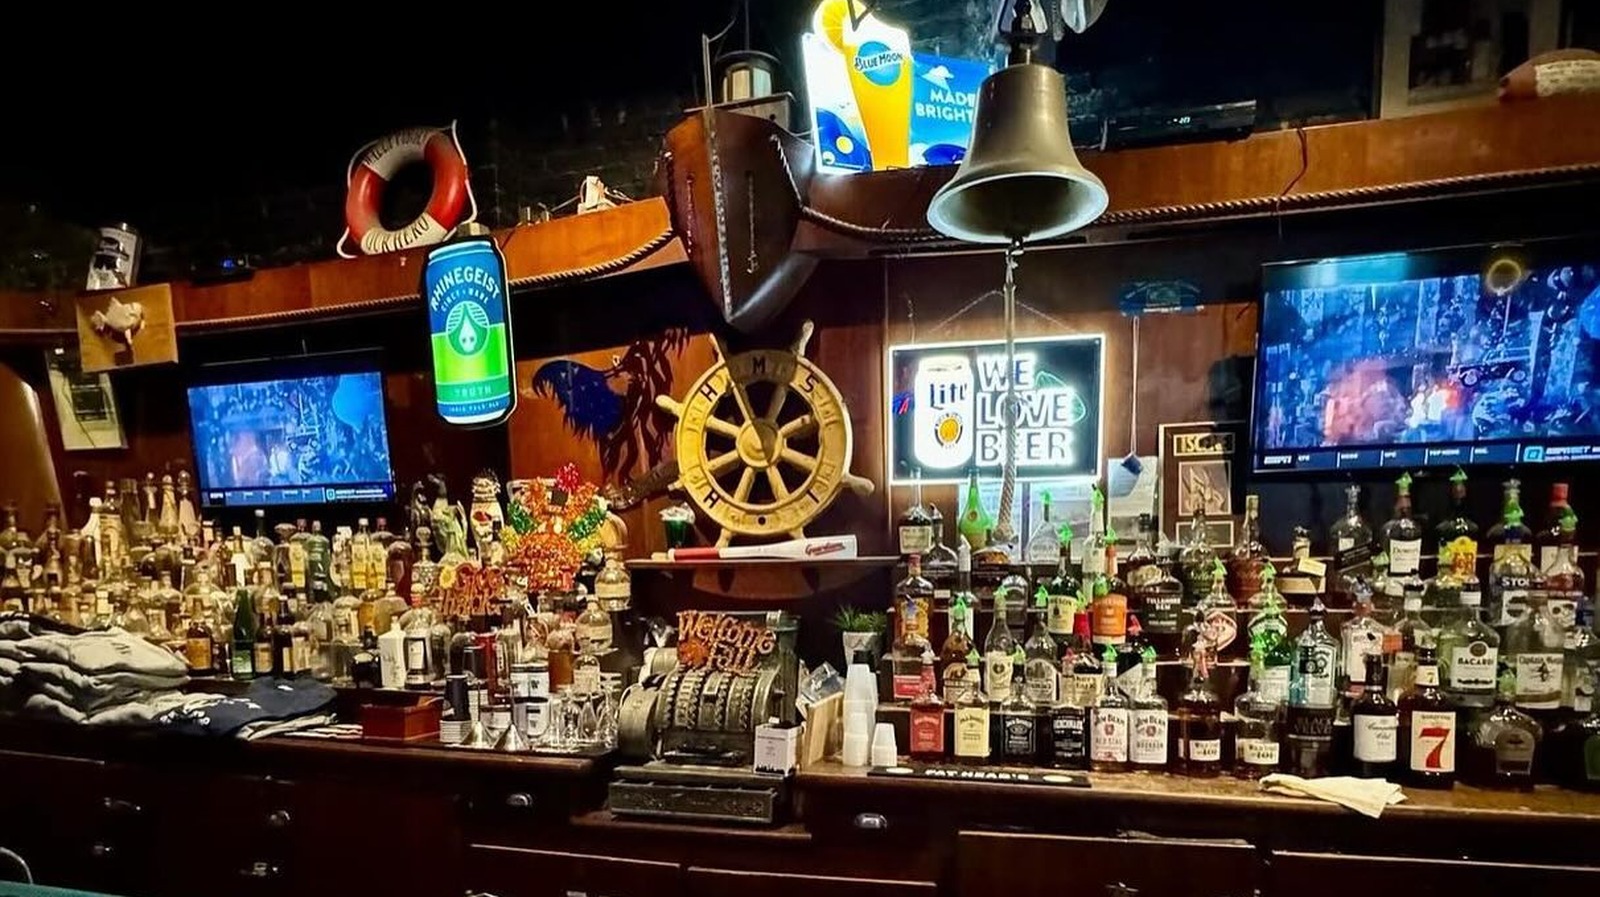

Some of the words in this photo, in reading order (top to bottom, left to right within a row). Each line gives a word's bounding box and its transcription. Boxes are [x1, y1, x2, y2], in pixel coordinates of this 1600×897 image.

[854, 56, 878, 71] BLUE
[879, 51, 904, 64] MOON
[930, 89, 976, 107] MADE
[431, 266, 500, 311] RHINEGEIST
[978, 357, 1030, 389] WE
[979, 392, 1069, 424] LOVE
[677, 610, 777, 655] Welcome
[708, 641, 758, 673] Fall
[1457, 657, 1494, 666] BACARDI
[1418, 727, 1451, 769] 7
